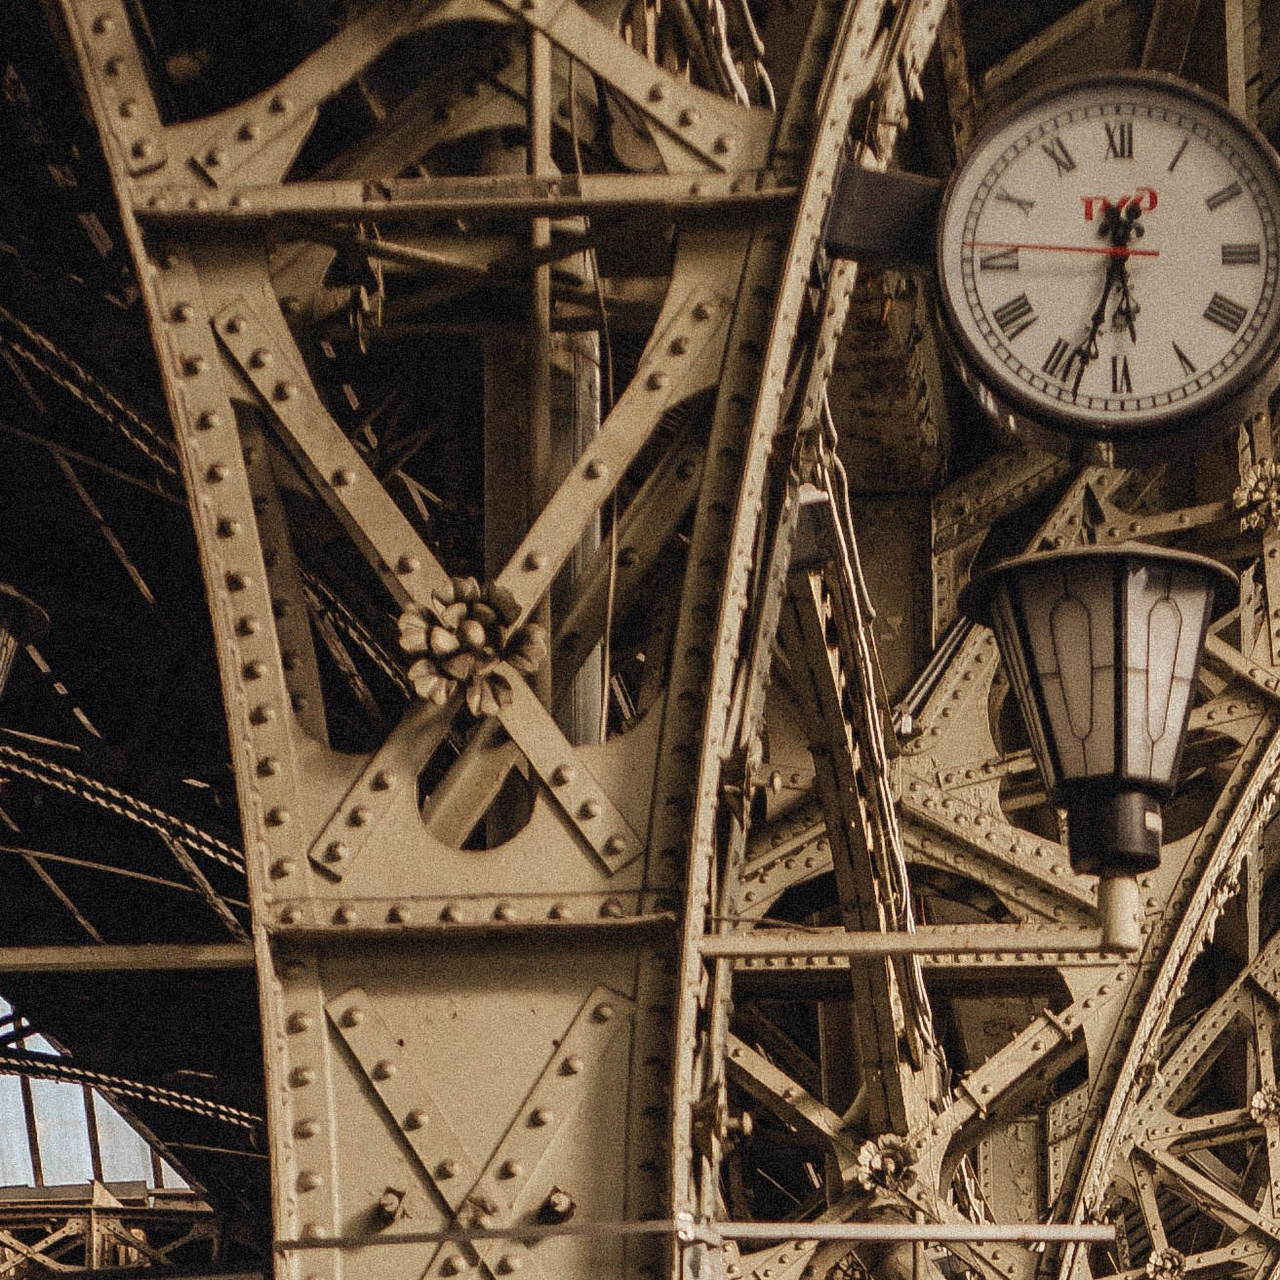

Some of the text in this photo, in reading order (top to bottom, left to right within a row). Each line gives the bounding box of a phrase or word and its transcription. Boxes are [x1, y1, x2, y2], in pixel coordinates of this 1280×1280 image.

[1041, 136, 1077, 177] XI
[1104, 121, 1133, 160] XII
[995, 189, 1036, 216] X
